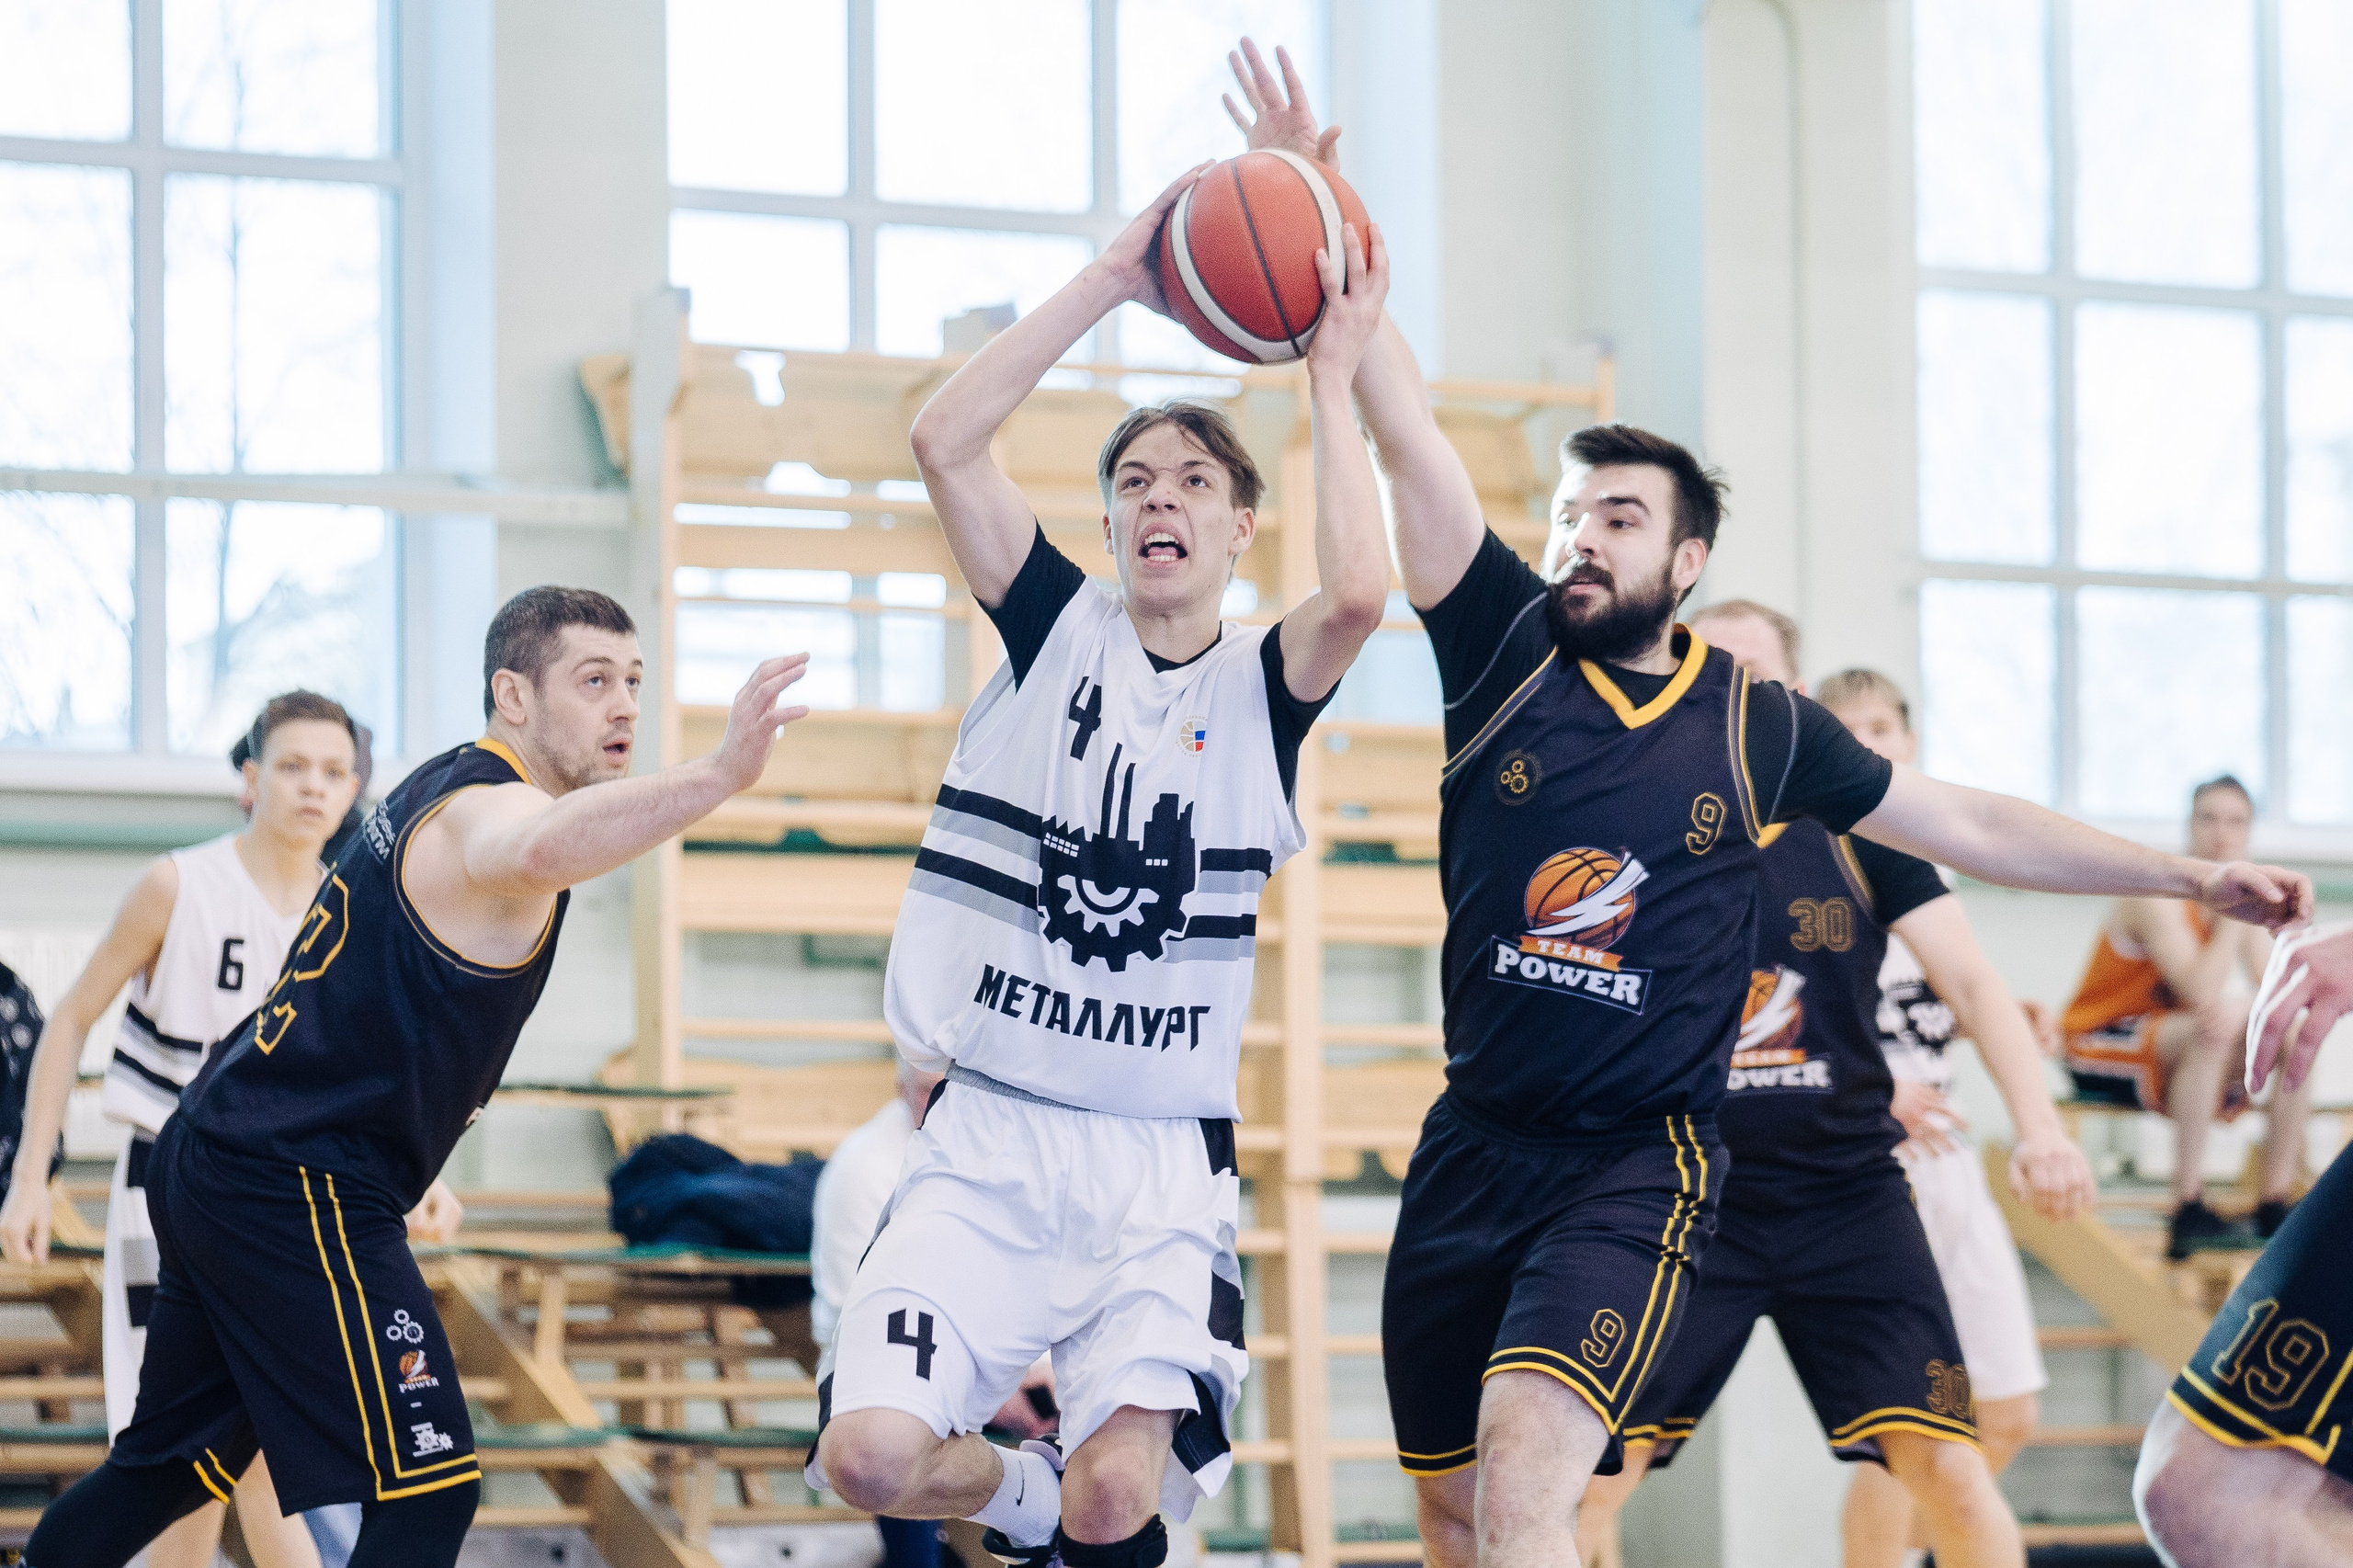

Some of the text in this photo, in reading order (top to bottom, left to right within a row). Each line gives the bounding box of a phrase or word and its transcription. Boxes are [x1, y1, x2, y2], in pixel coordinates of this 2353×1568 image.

[1068, 676, 1102, 761] 4
[1686, 791, 1728, 856] 9
[1537, 939, 1605, 965] TEAM
[1787, 896, 1857, 953] 30
[218, 937, 244, 991] 6
[1494, 943, 1643, 1006] POWER
[973, 963, 1211, 1053] МЕТАЛЛУРГ
[1726, 1059, 1833, 1091] OWER
[887, 1308, 938, 1381] 4
[1580, 1308, 1629, 1369] 9
[2211, 1296, 2331, 1412] 19
[398, 1376, 439, 1394] POWER
